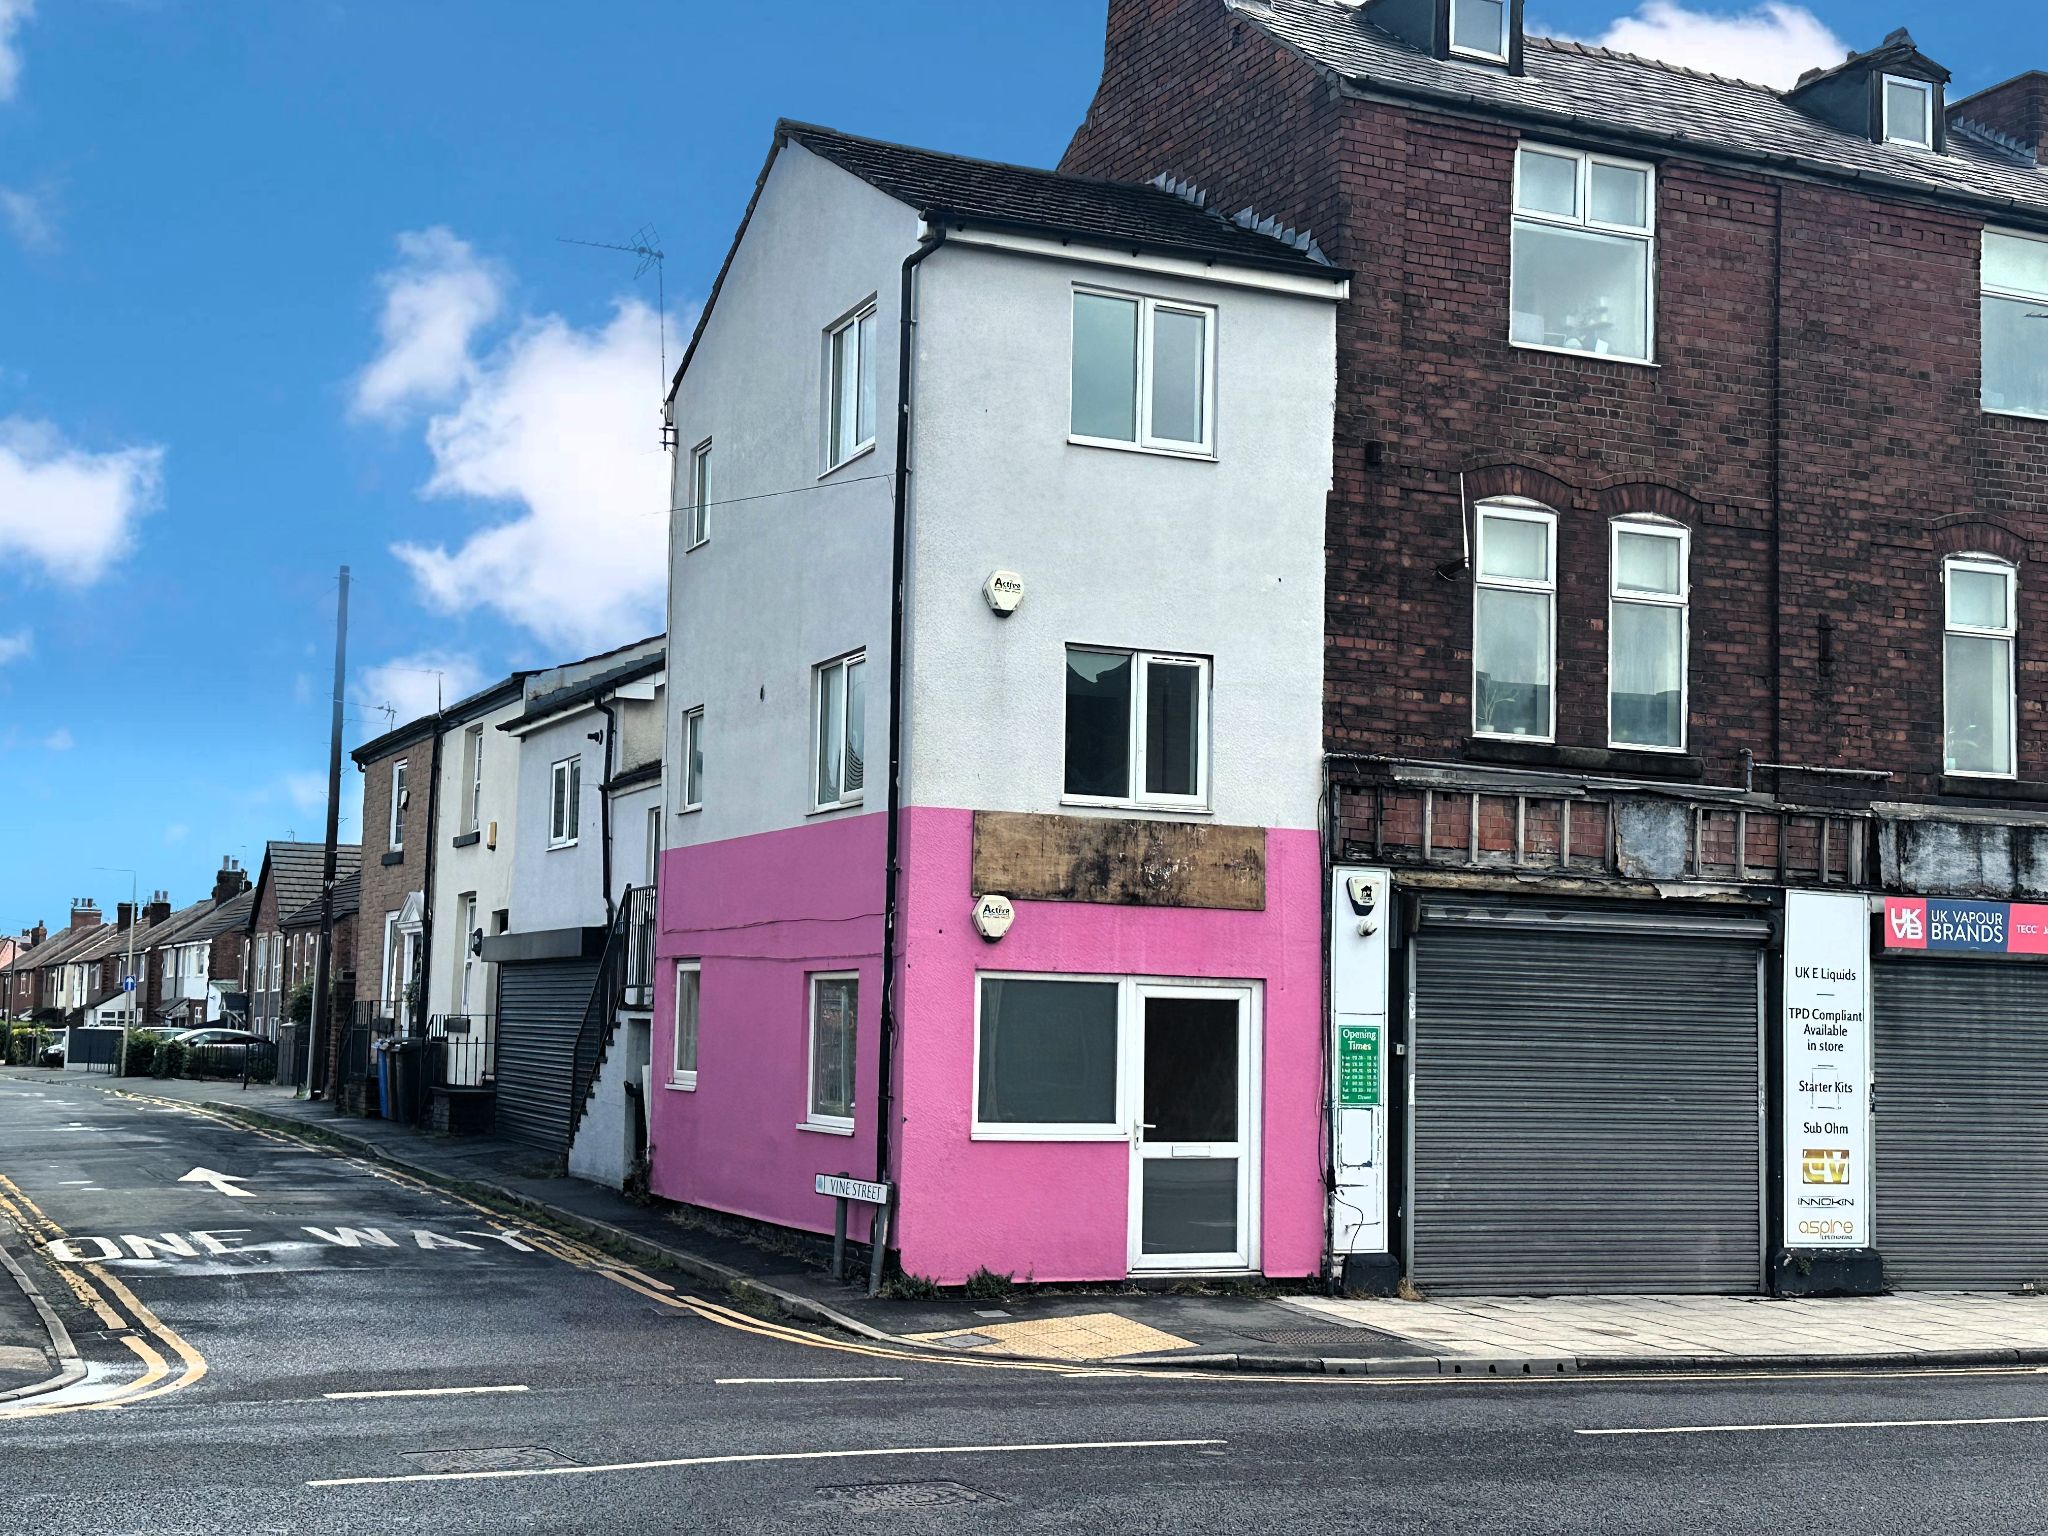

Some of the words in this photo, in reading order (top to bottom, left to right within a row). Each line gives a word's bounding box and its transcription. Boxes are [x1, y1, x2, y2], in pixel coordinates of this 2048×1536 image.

[1931, 909, 1948, 923] UK
[1952, 910, 2003, 926] VAPOUR
[1931, 922, 2004, 944] BRANDS
[1795, 966, 1810, 979] UK
[1812, 967, 1819, 979] E
[1821, 967, 1857, 983] Liquids
[1788, 1007, 1810, 1020] TPD
[1812, 1008, 1863, 1024] Compliant
[1342, 1028, 1377, 1041] Opening
[1803, 1023, 1848, 1037] Available
[1348, 1040, 1372, 1051] Times
[1807, 1038, 1817, 1051] in
[1819, 1041, 1844, 1052] store
[1798, 1080, 1832, 1093] Starter
[1834, 1081, 1853, 1093] Kits
[1803, 1121, 1822, 1134] Sub
[1824, 1122, 1849, 1135] Ohm
[830, 1179, 851, 1196] VINE
[851, 1182, 882, 1201] STREET
[1798, 1218, 1854, 1237] aspire
[47, 1229, 252, 1262] ONE
[300, 1226, 536, 1252] WAY
